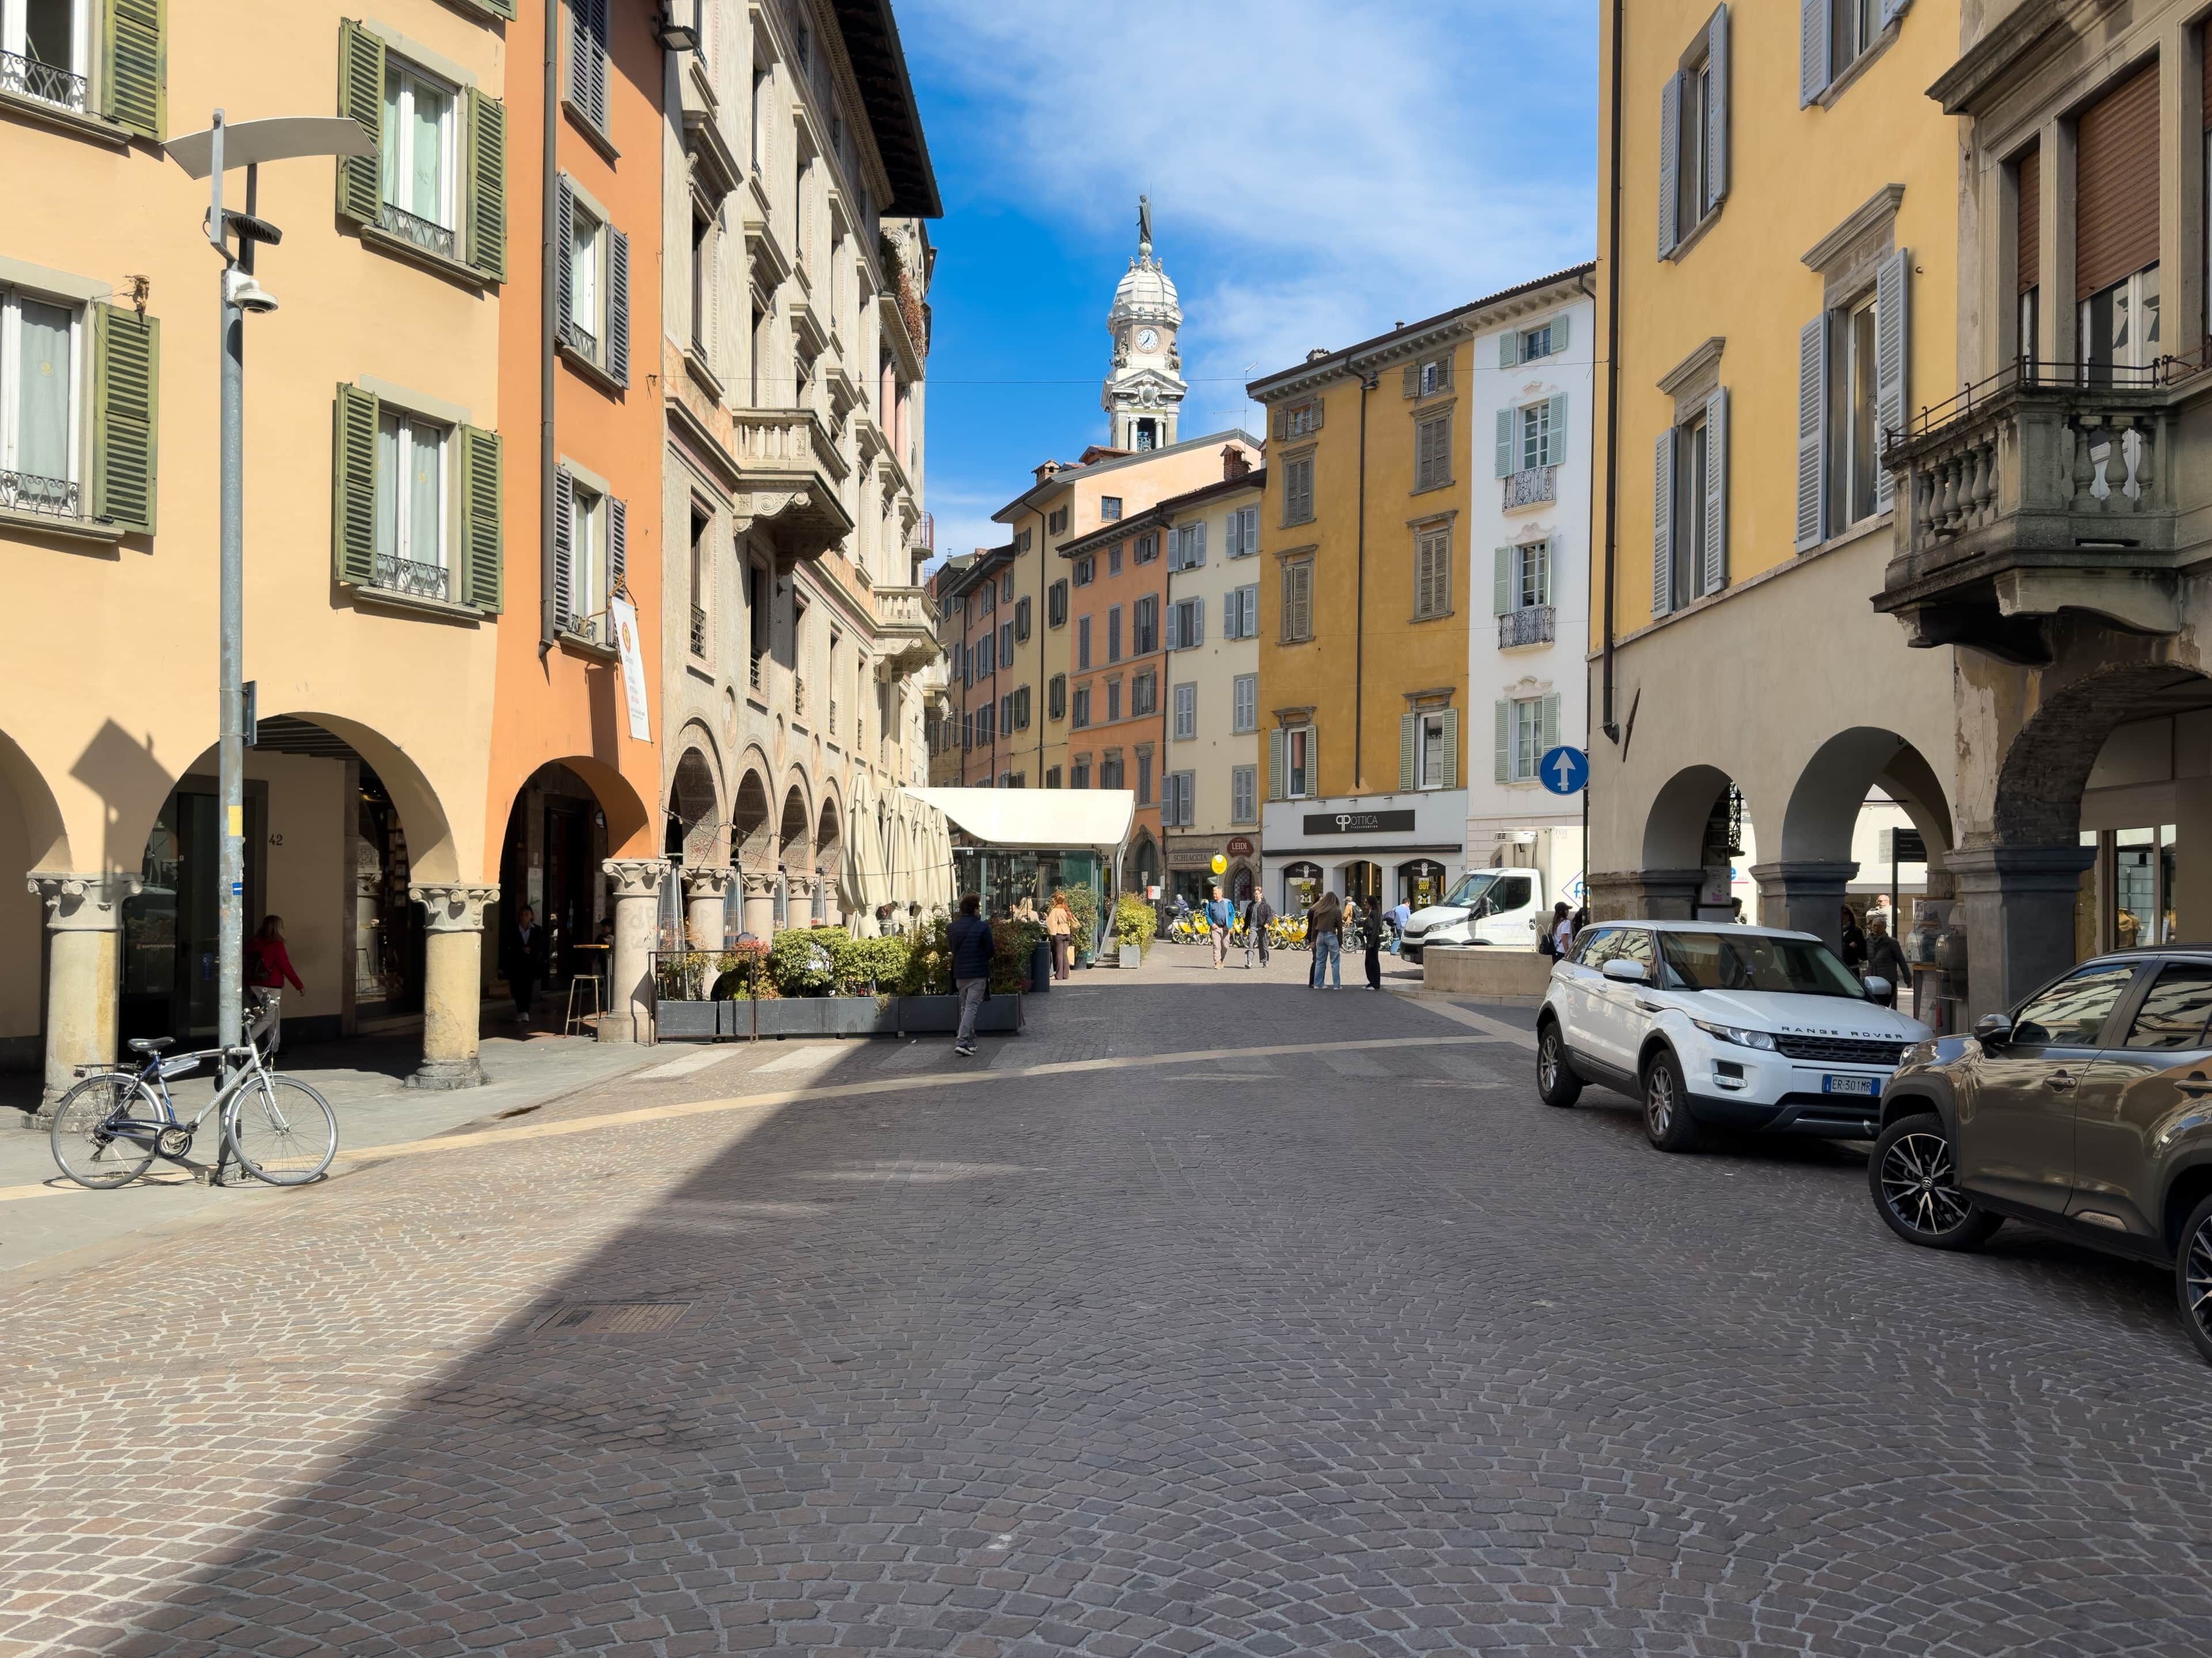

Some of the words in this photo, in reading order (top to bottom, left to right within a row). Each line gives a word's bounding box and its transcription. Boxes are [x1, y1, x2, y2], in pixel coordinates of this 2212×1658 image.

[1350, 815, 1378, 825] OTTICA
[269, 834, 282, 845] 42
[1418, 895, 1431, 904] 2x1
[1781, 1026, 1839, 1035] RANGE
